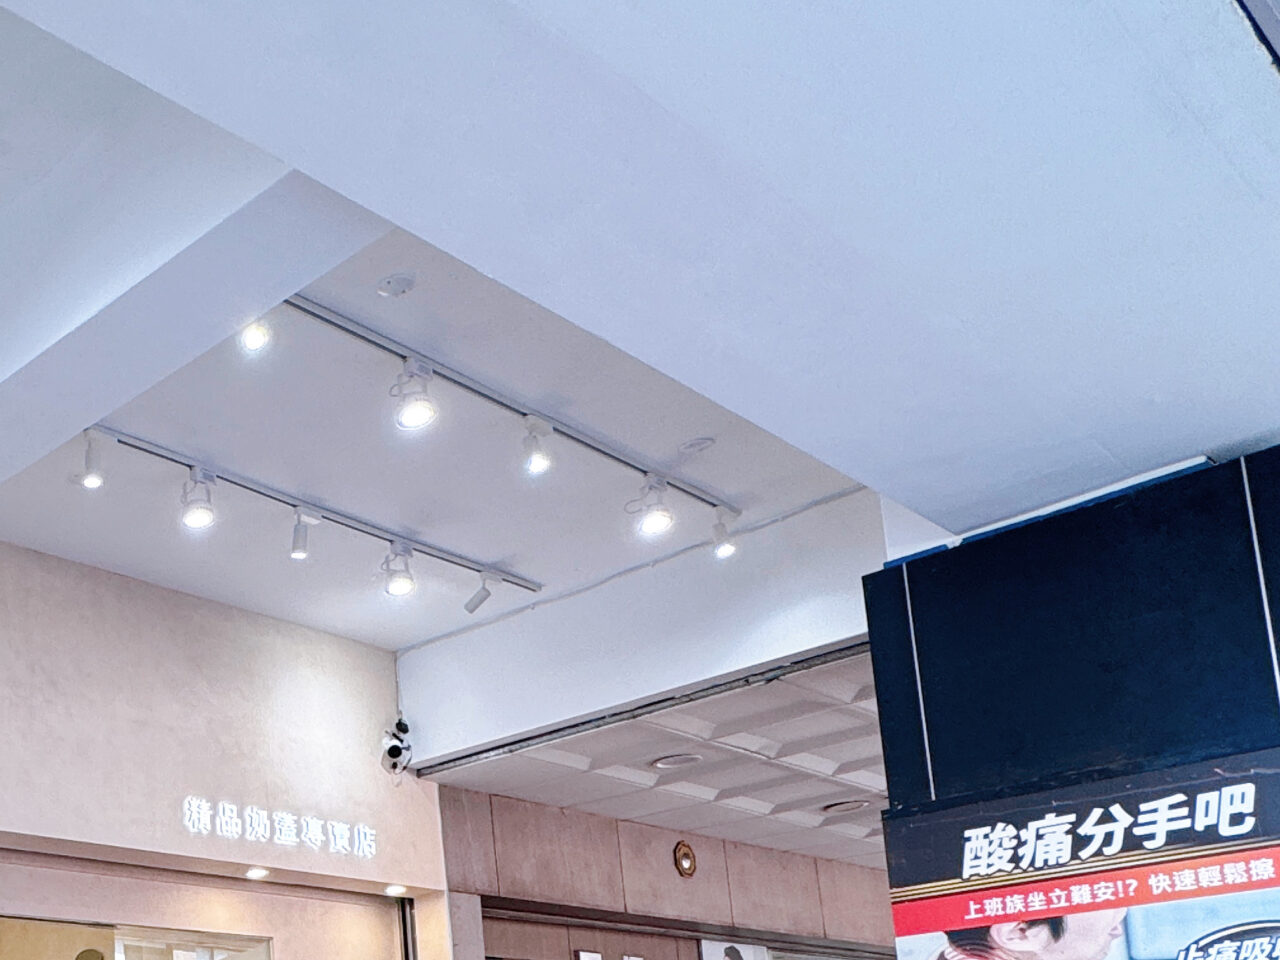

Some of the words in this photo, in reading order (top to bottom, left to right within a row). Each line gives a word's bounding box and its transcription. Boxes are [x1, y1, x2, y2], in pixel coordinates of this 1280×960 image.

[962, 782, 1257, 880] 酸痛分手吧
[1148, 857, 1276, 895] 快速輕鬆擦
